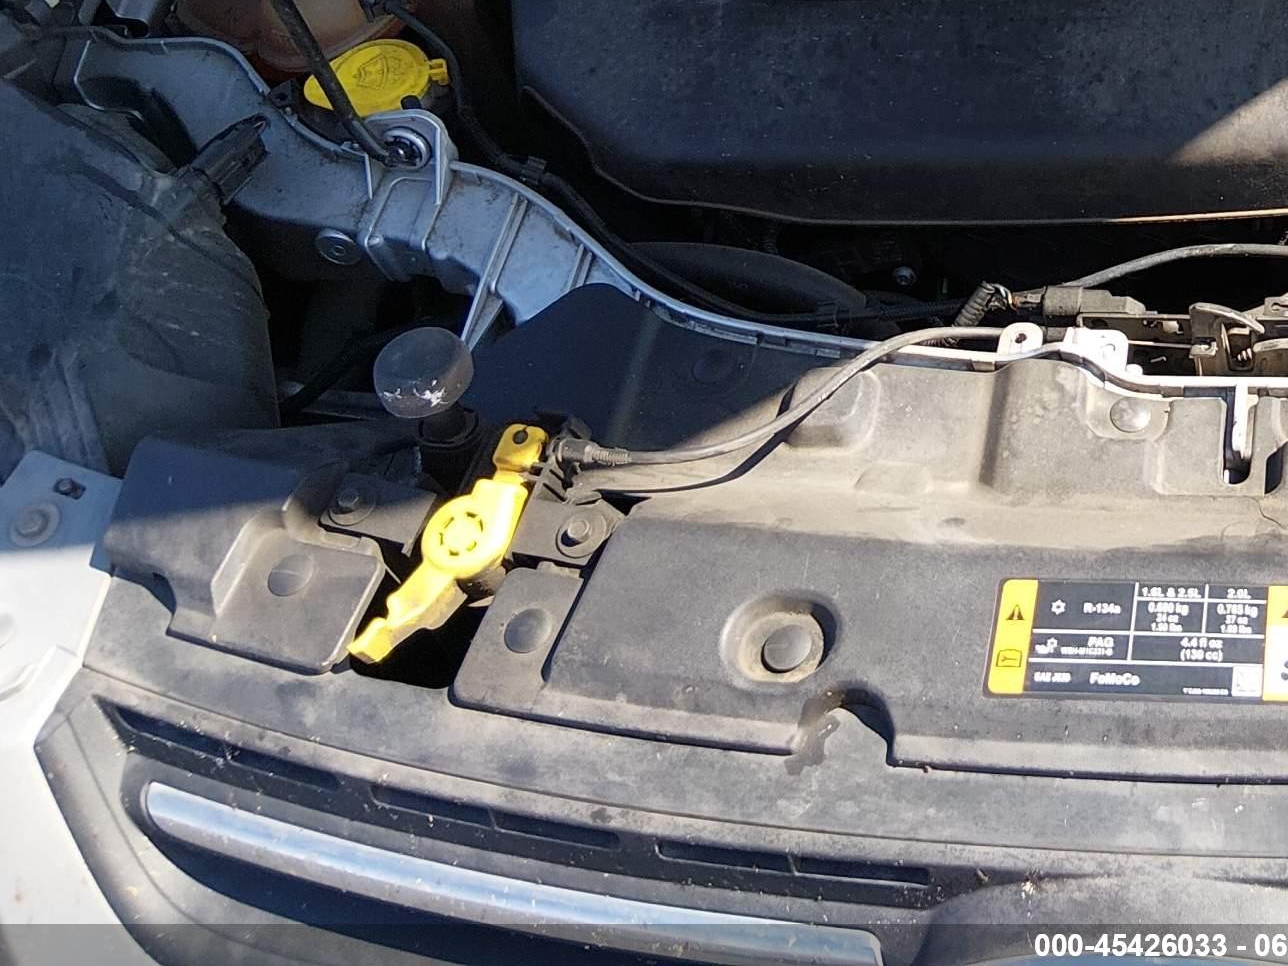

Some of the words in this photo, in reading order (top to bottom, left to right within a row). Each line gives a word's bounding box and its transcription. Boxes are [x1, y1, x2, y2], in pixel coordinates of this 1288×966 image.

[1083, 602, 1121, 614] R-134a
[1176, 603, 1189, 616] kg
[1245, 605, 1258, 617] kg
[1087, 636, 1114, 647] PAG
[1181, 638, 1197, 648] 4.4
[1199, 638, 1208, 648] fl
[1209, 640, 1223, 648] oz
[1206, 650, 1223, 661] cc)
[1089, 672, 1141, 686] FoMoCo
